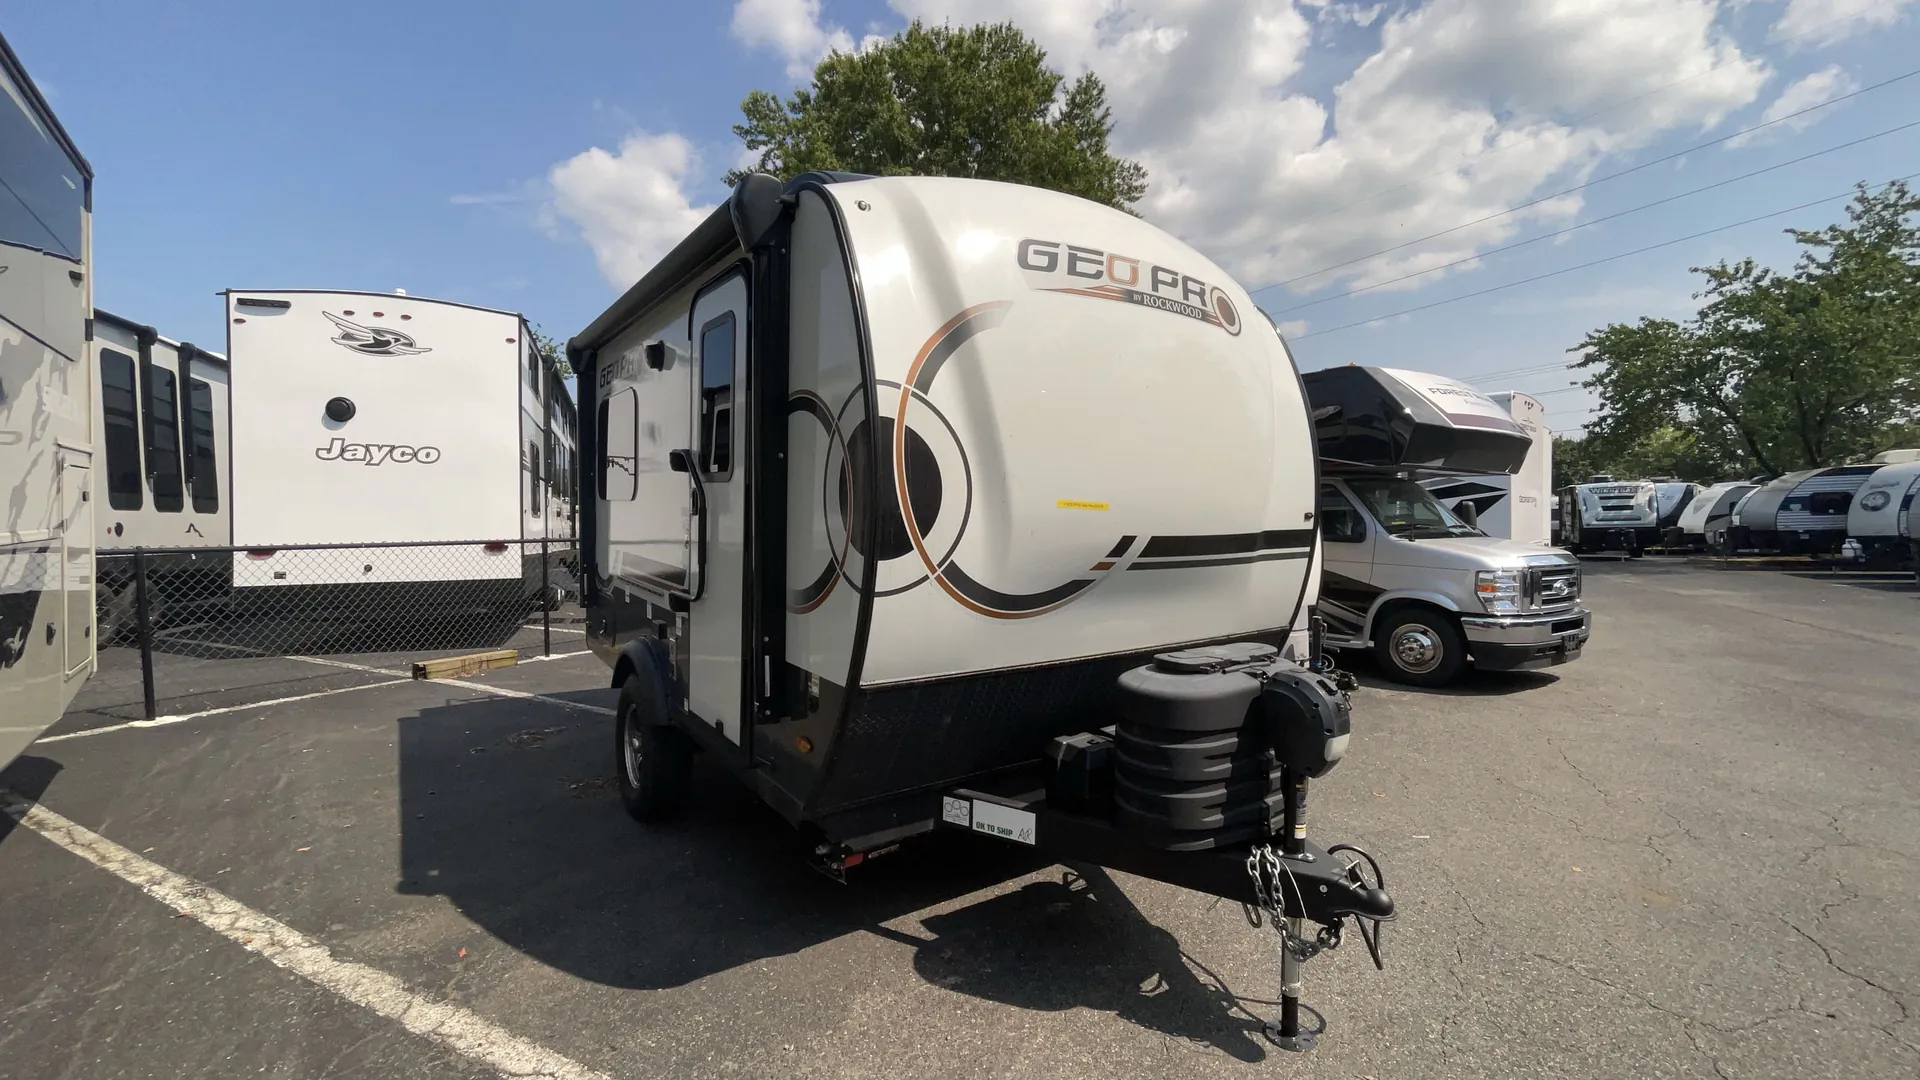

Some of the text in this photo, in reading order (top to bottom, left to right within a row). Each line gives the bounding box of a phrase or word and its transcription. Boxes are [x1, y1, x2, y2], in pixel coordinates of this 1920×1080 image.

[1017, 239, 1242, 337] GEO PRO
[1133, 293, 1202, 319] BY ROCKWOOD
[315, 437, 441, 465] Jayco
[976, 821, 1013, 836] OK TO SHIP
